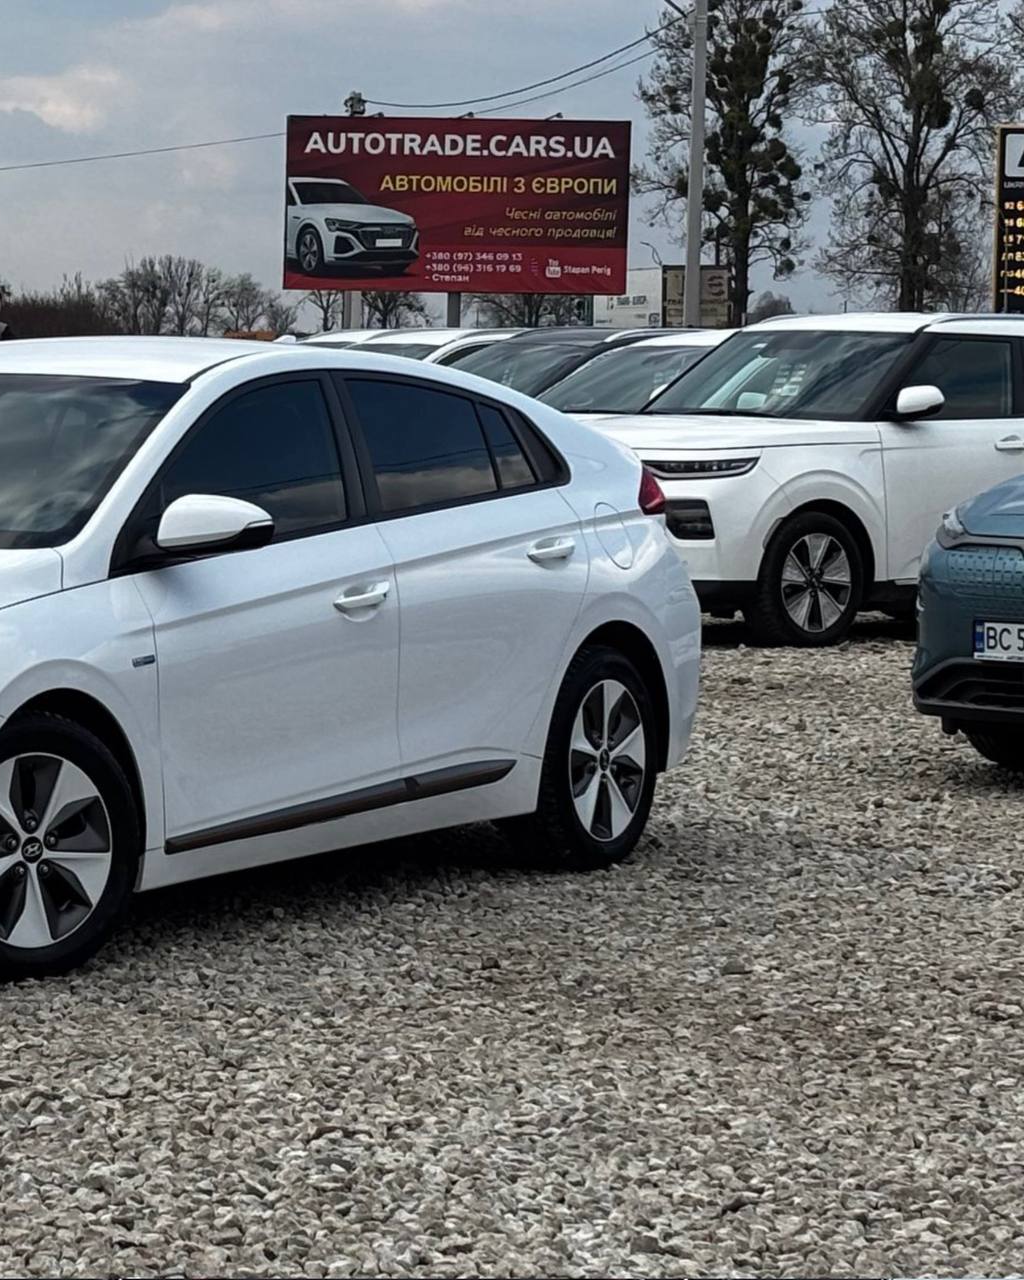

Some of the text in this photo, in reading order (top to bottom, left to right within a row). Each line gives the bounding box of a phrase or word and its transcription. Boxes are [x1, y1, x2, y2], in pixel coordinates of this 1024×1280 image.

[304, 131, 616, 159] AUTOTRADE.CARS.UA
[380, 175, 507, 193] АВТОМОБІЛІ
[531, 177, 617, 195] ЄВРОПИ
[505, 206, 617, 221] Чесні автомобілі
[464, 225, 484, 237] від
[489, 226, 543, 237] чесного
[986, 626, 1012, 651] BC
